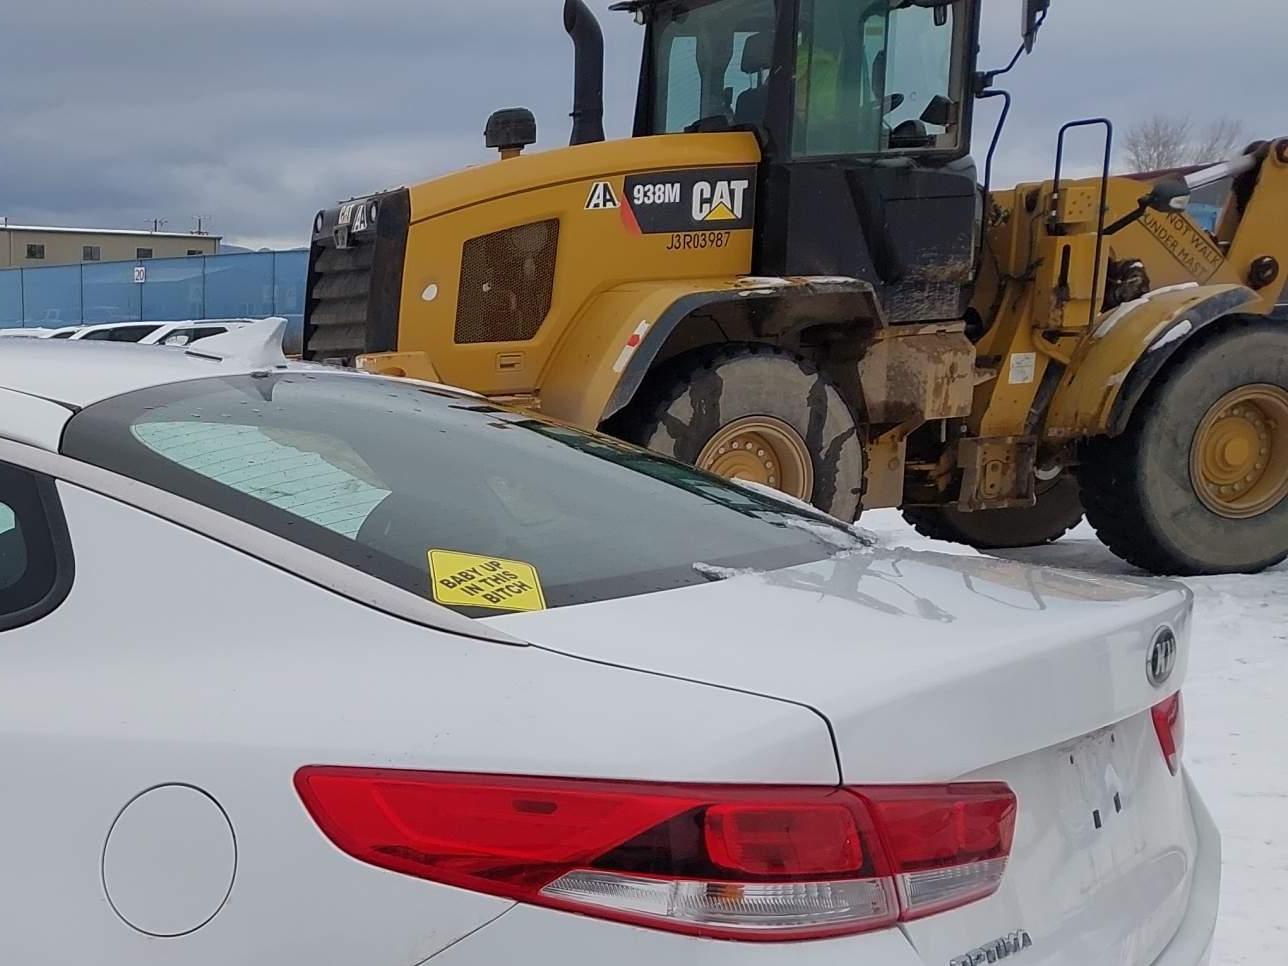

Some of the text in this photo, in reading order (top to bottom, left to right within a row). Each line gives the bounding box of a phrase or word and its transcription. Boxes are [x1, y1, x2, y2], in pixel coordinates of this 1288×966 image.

[634, 183, 680, 204] 938M
[692, 180, 748, 221] CAT
[666, 231, 731, 250] J3R03987
[1144, 214, 1207, 276] UNDER MAST
[1166, 213, 1219, 265] NOT WALK
[135, 269, 145, 281] 20
[439, 560, 503, 589] BABY UP
[460, 570, 519, 596] IN THIS
[482, 581, 533, 604] BITCH
